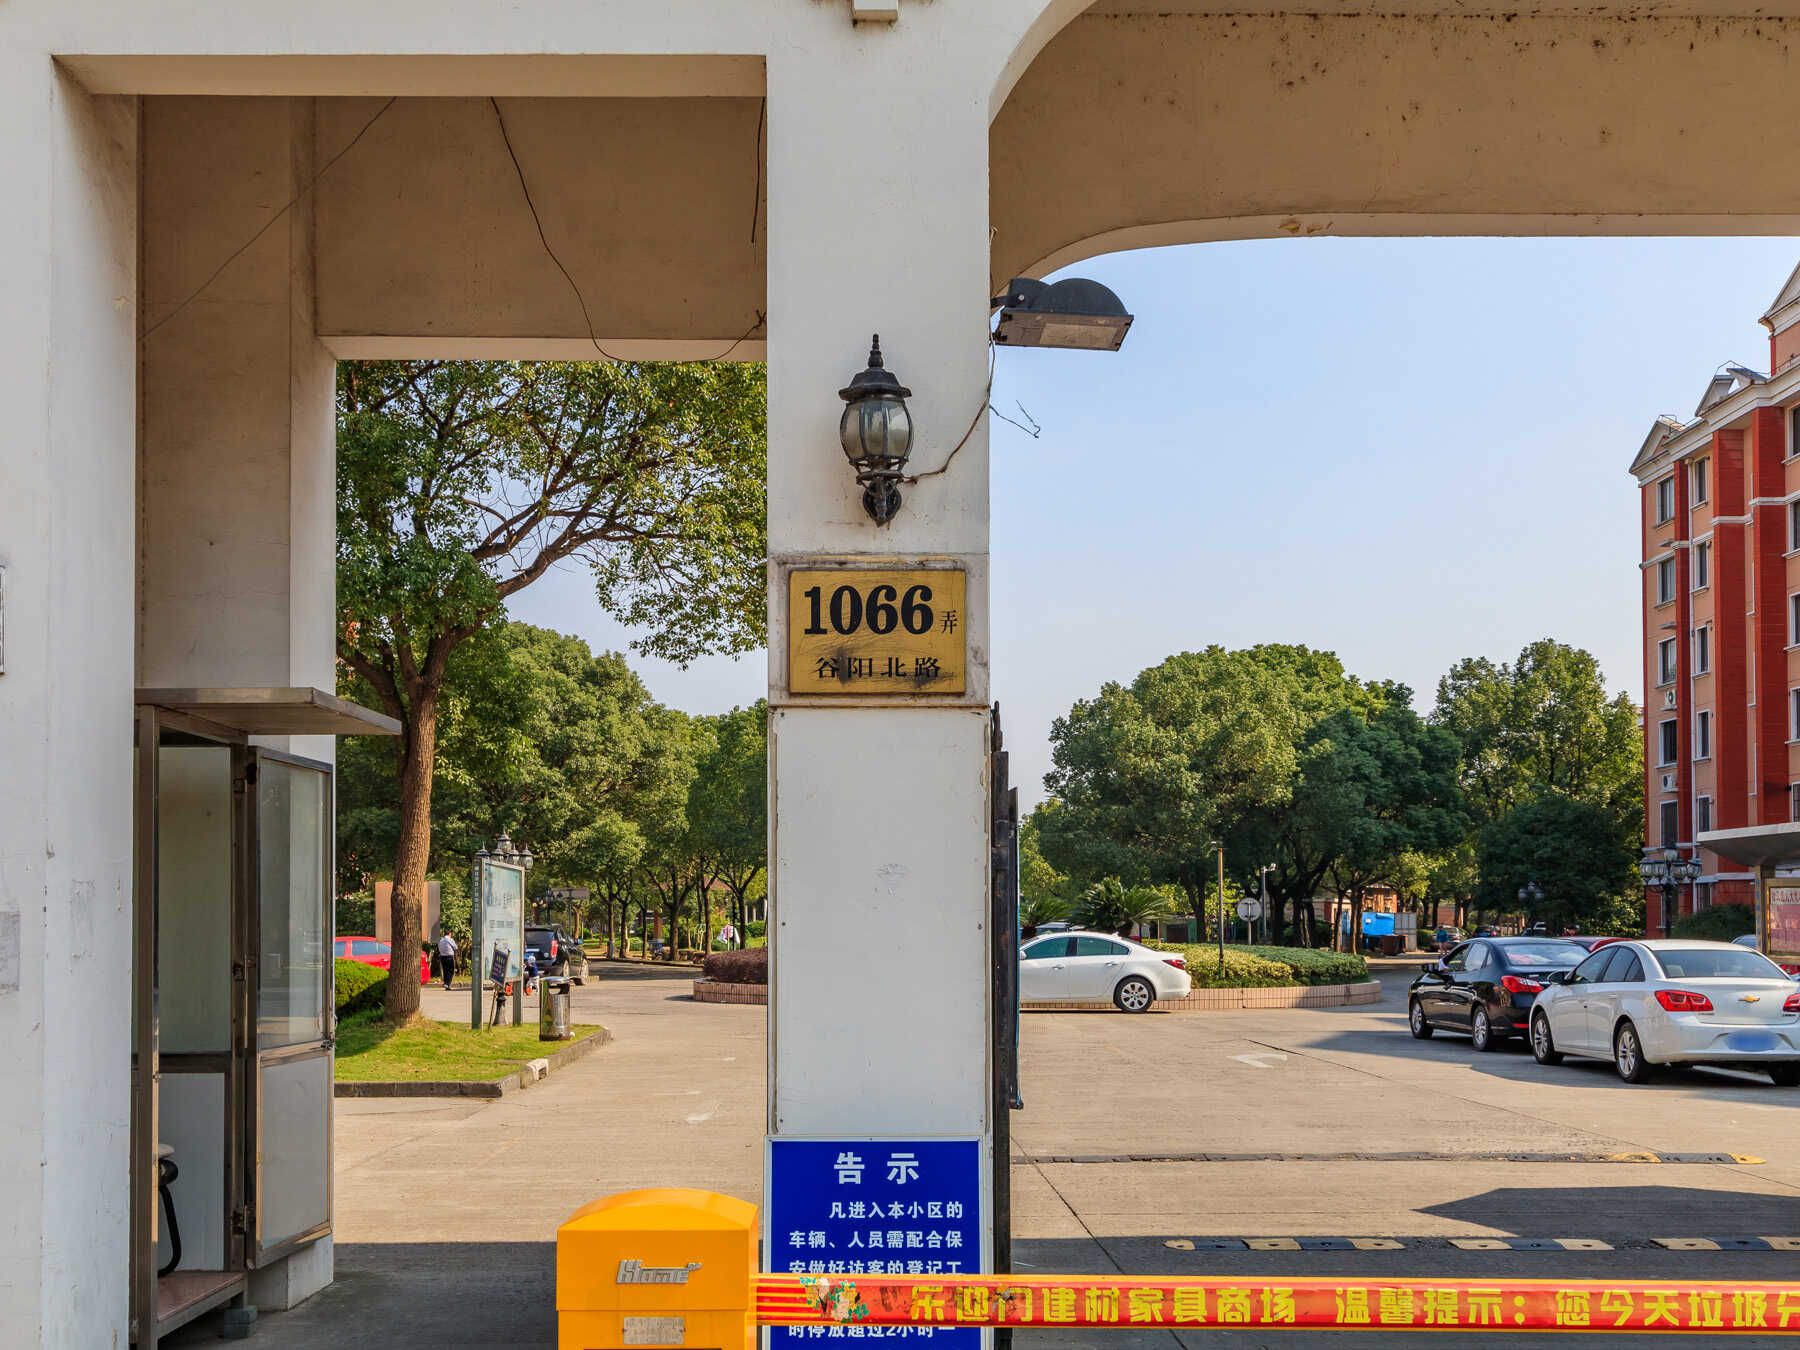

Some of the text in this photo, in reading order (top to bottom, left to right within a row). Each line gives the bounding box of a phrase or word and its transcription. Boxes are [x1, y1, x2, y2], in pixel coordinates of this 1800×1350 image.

[814, 656, 941, 679] 谷阳北路
[833, 1151, 919, 1185] 告示
[828, 1201, 963, 1219] 凡进入本小区的
[788, 1230, 963, 1249] 车辆、人员需配合保
[788, 1260, 962, 1274] 安做好访客的登记工
